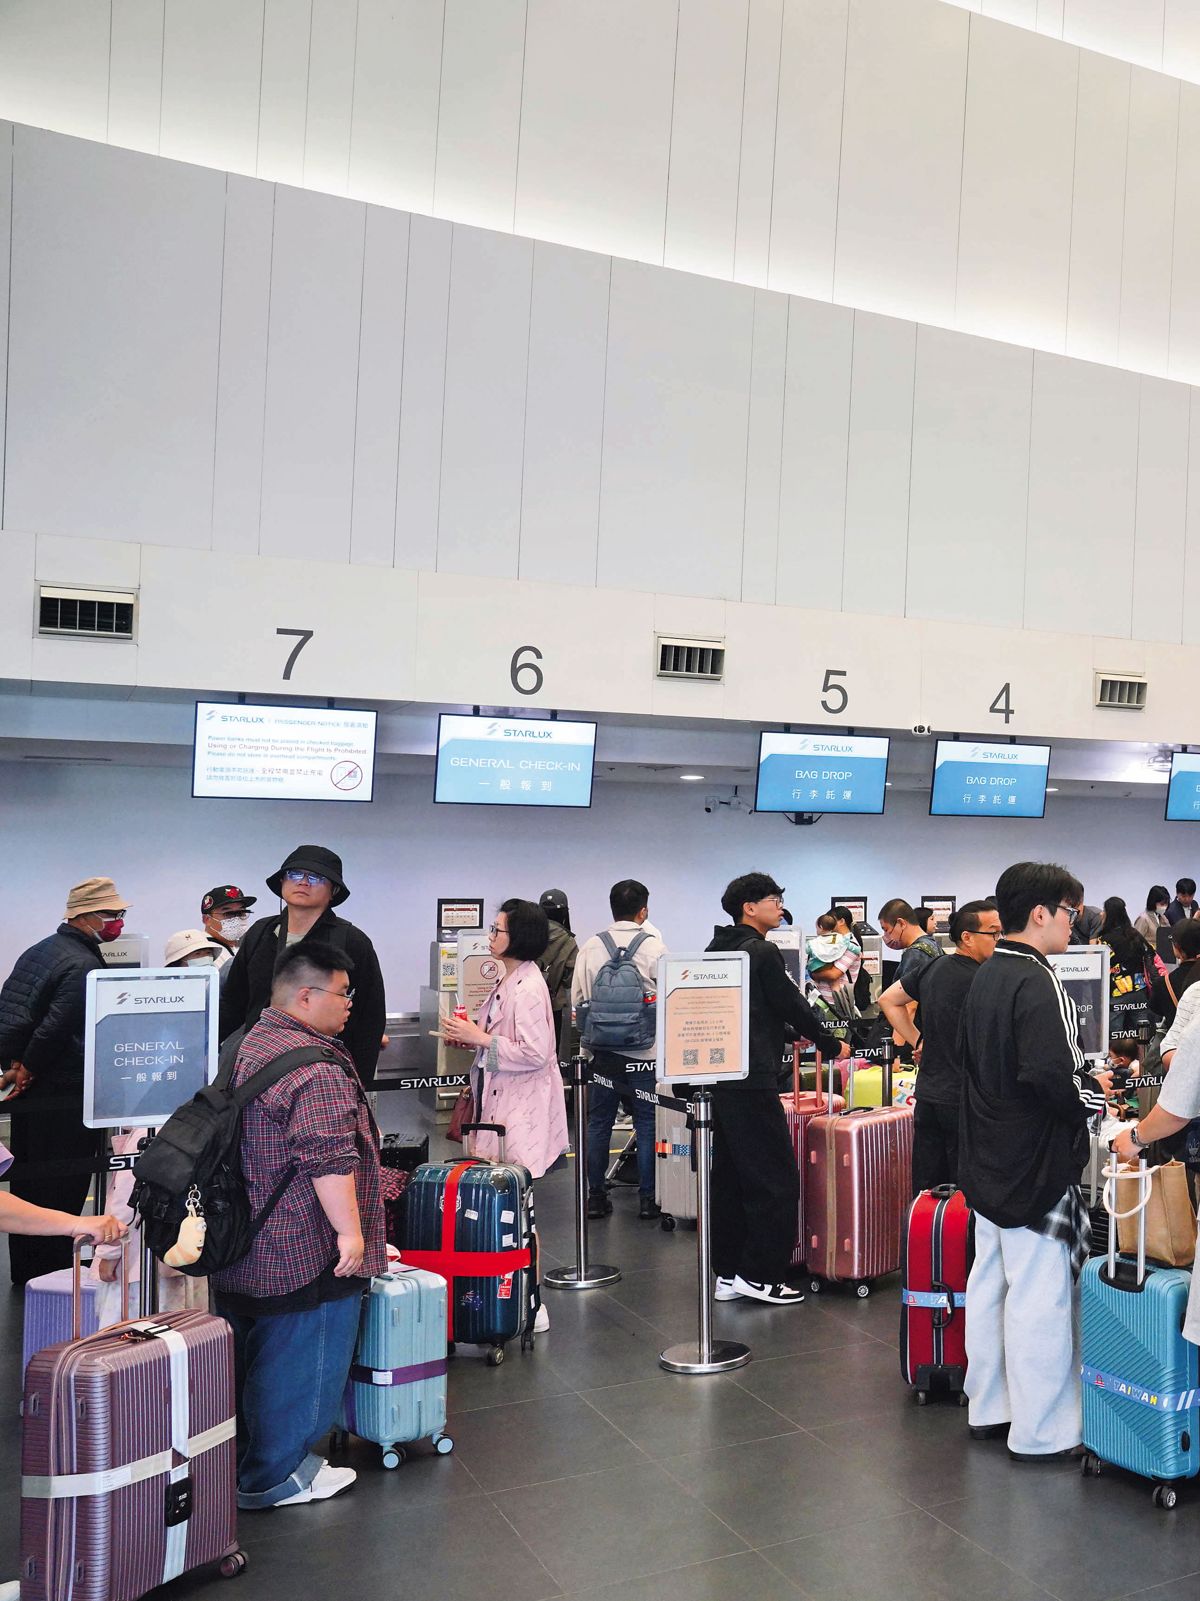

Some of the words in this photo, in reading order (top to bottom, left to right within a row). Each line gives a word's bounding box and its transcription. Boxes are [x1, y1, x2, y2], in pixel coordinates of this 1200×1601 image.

[276, 628, 315, 681] 7
[509, 645, 544, 695] 6
[820, 669, 849, 715] 5
[988, 682, 1015, 724] 4
[221, 715, 265, 724] STARLUX
[503, 729, 553, 739] STARLUX
[207, 742, 228, 751] Using
[238, 743, 270, 752] Charging
[270, 744, 293, 753] During
[306, 746, 326, 755] Flight
[334, 747, 367, 755] Prohibited
[813, 744, 853, 753] STARLUX
[982, 752, 1018, 760] STARLUX
[450, 757, 515, 769] GENERAL
[520, 760, 581, 772] CHECK-IN
[795, 770, 818, 780] BAG
[822, 771, 853, 780] DROP
[966, 776, 987, 785] BAG
[989, 777, 1017, 786] DROP
[479, 778, 552, 792] 一般報到
[791, 788, 852, 801] 行李託運
[963, 793, 1017, 805] 行李託運
[134, 995, 185, 1005] STARLUX
[1113, 1002, 1148, 1012] STARLUX
[821, 1020, 849, 1029] ARLUX
[1111, 1030, 1139, 1040] STARL
[114, 1041, 185, 1053] GENERAL
[855, 1048, 883, 1058] STAR
[114, 1055, 184, 1067] CHECK-IN
[625, 1062, 657, 1073] STAR
[120, 1071, 177, 1083] 一般報到
[400, 1074, 467, 1090] STARLUX
[593, 1073, 615, 1090] STARLUX
[635, 1089, 660, 1105] STARLUX
[1113, 1380, 1158, 1405] TAIWAN
